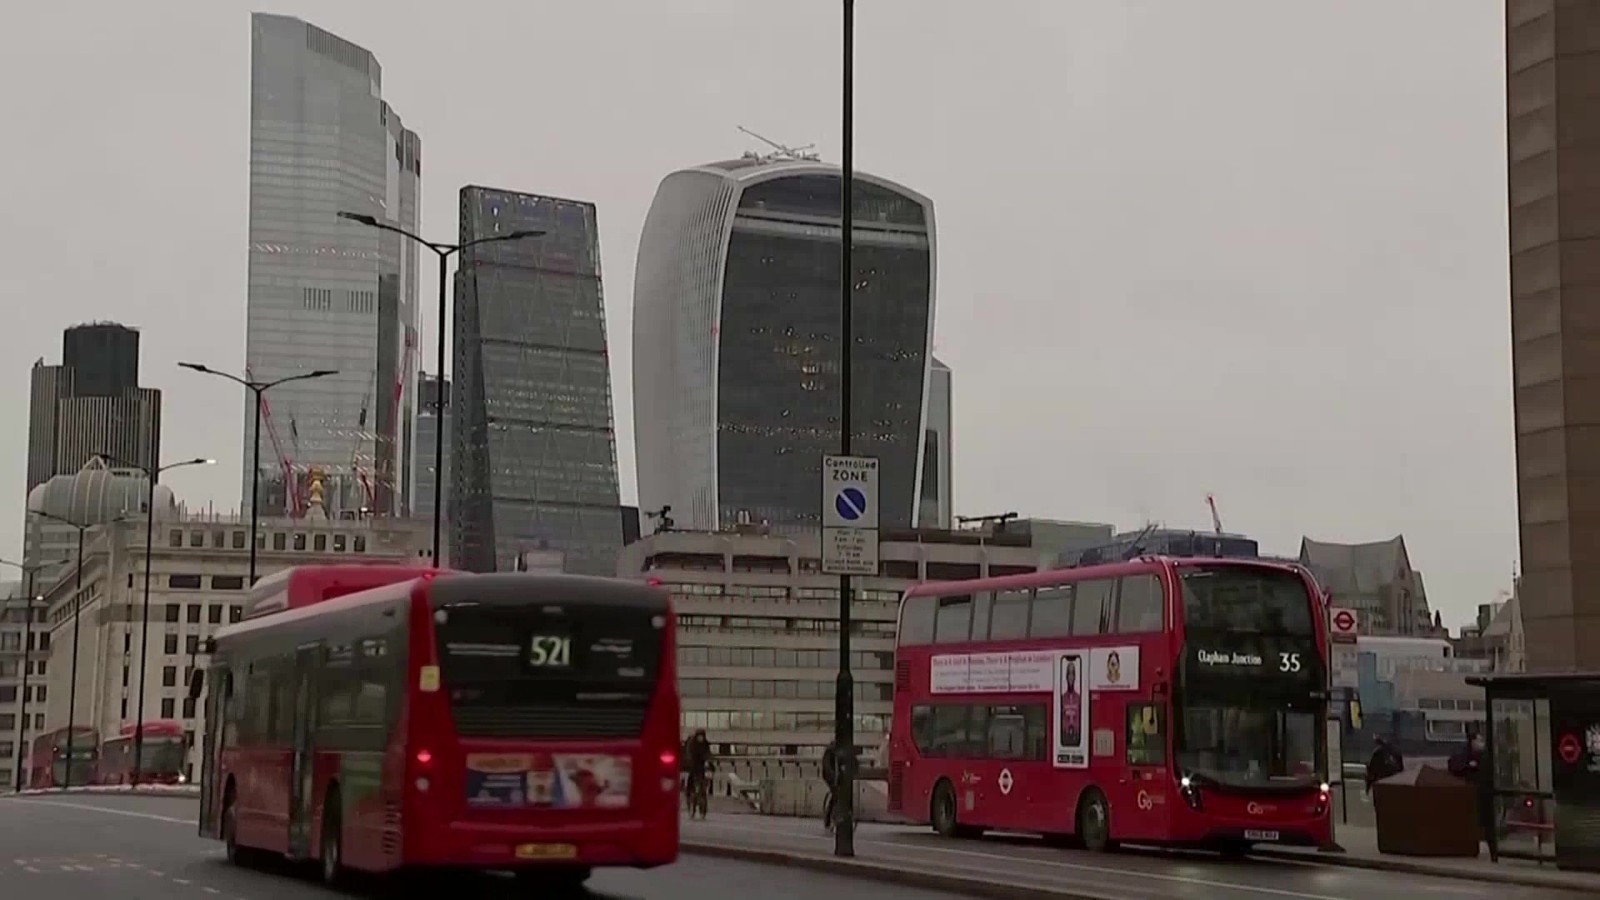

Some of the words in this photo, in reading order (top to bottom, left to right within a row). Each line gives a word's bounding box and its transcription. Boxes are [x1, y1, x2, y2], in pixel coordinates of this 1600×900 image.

[825, 457, 877, 469] Controlled
[832, 469, 868, 482] ZONE
[529, 635, 570, 666] 521
[1198, 649, 1230, 666] Clapham
[1231, 652, 1262, 665] Junction
[1279, 652, 1300, 672] 35
